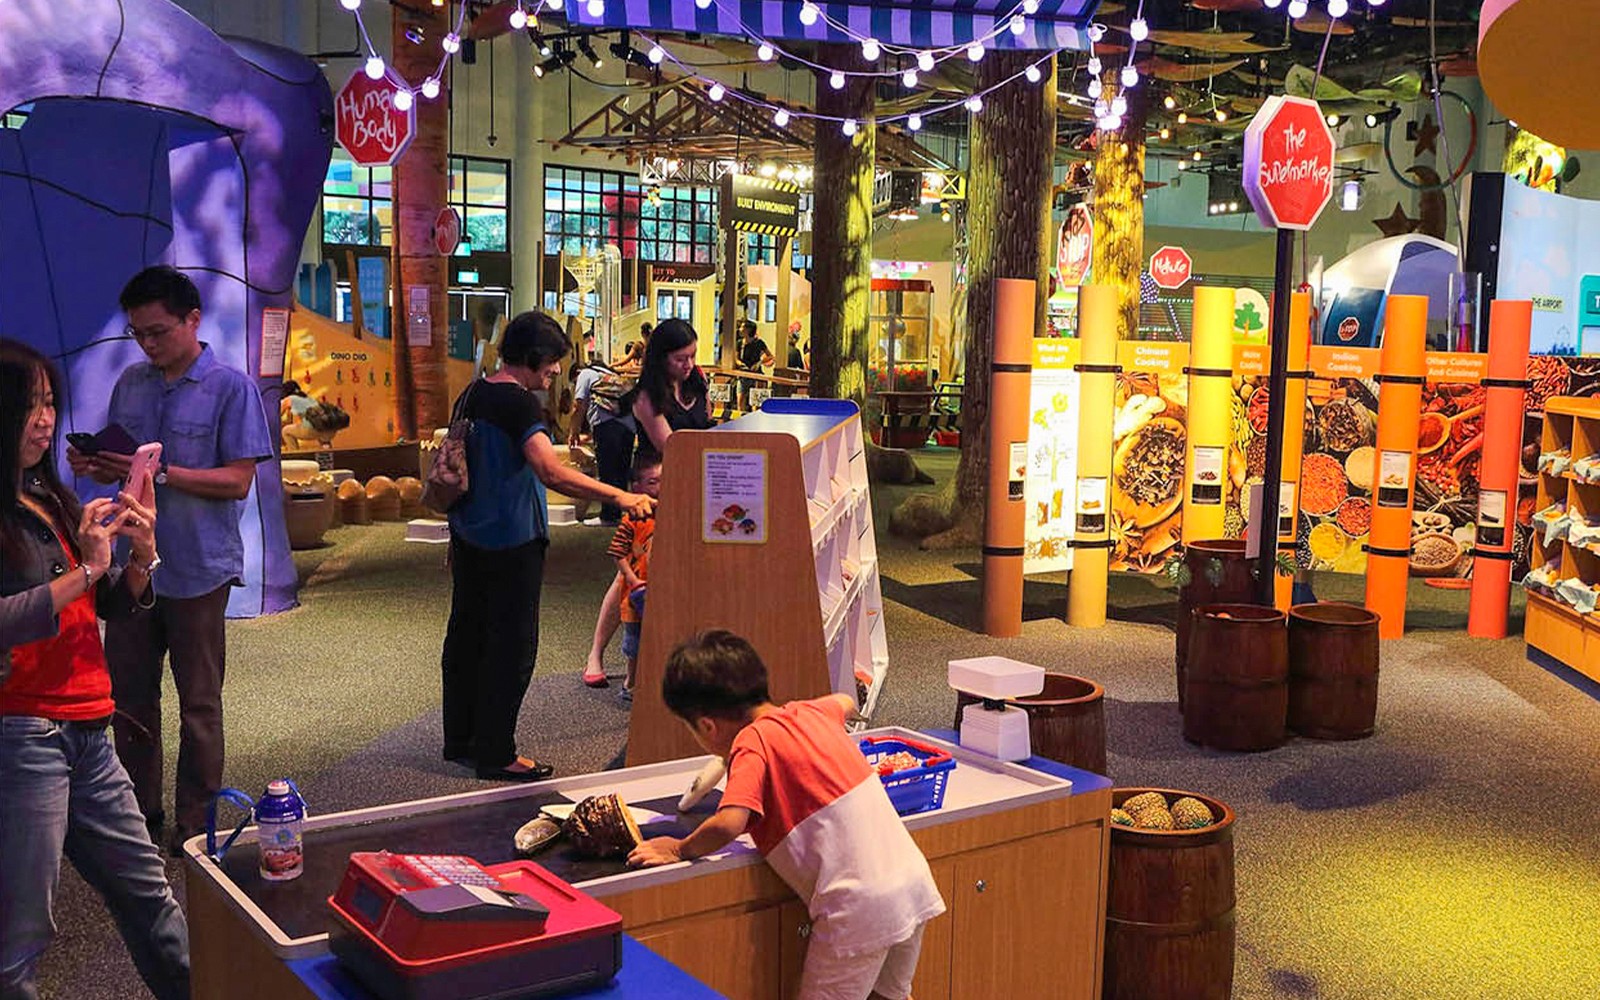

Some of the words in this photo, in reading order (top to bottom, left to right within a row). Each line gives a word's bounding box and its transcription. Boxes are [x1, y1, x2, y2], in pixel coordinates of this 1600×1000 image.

[340, 88, 404, 124] Huma
[353, 111, 397, 153] Body
[1283, 122, 1307, 155] The
[736, 196, 753, 209] BUILT
[754, 199, 796, 216] ENVIRONMENT
[1154, 256, 1187, 275] Nature
[330, 351, 351, 361] DINO
[352, 353, 367, 362] DIG
[1136, 346, 1170, 356] Chinese
[1134, 358, 1170, 369] Cooking
[1327, 362, 1363, 373] Cooking
[1426, 357, 1447, 366] Other
[1450, 358, 1483, 367] Cultures
